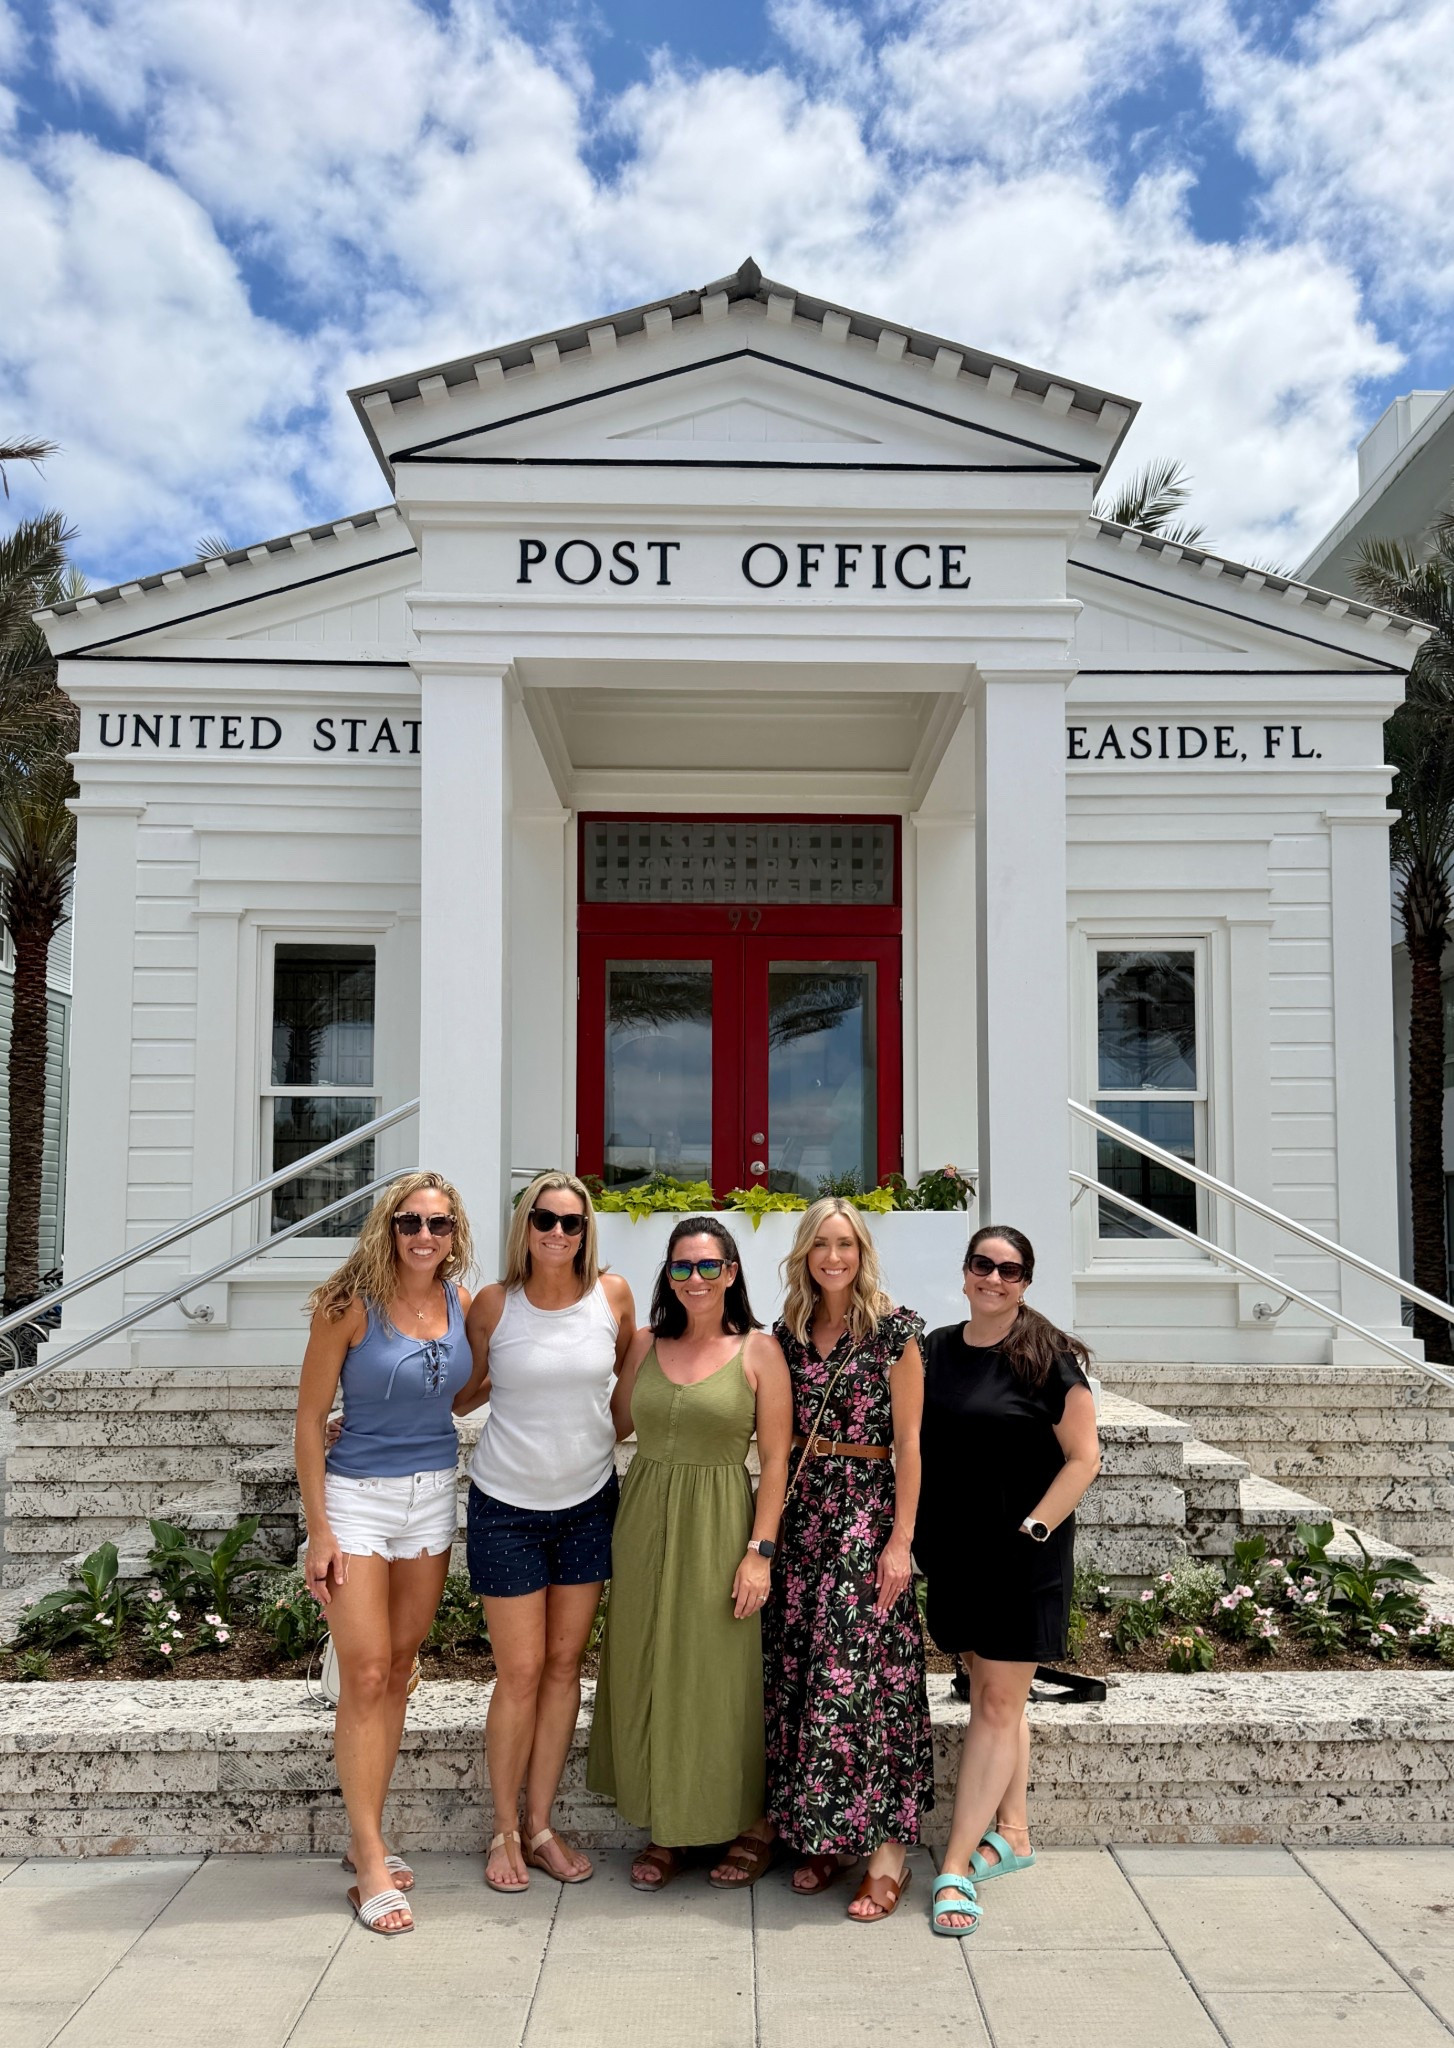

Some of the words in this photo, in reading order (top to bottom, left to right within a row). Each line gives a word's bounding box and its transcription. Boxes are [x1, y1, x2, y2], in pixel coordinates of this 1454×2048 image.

[516, 539, 680, 585] POST
[741, 542, 972, 588] OFFICE
[98, 713, 282, 749] UNITED
[1066, 724, 1248, 762] EASIDE,
[1263, 725, 1322, 759] FL.
[630, 857, 743, 878] CONTRAC
[602, 880, 661, 895] SATA
[728, 908, 762, 931] 99
